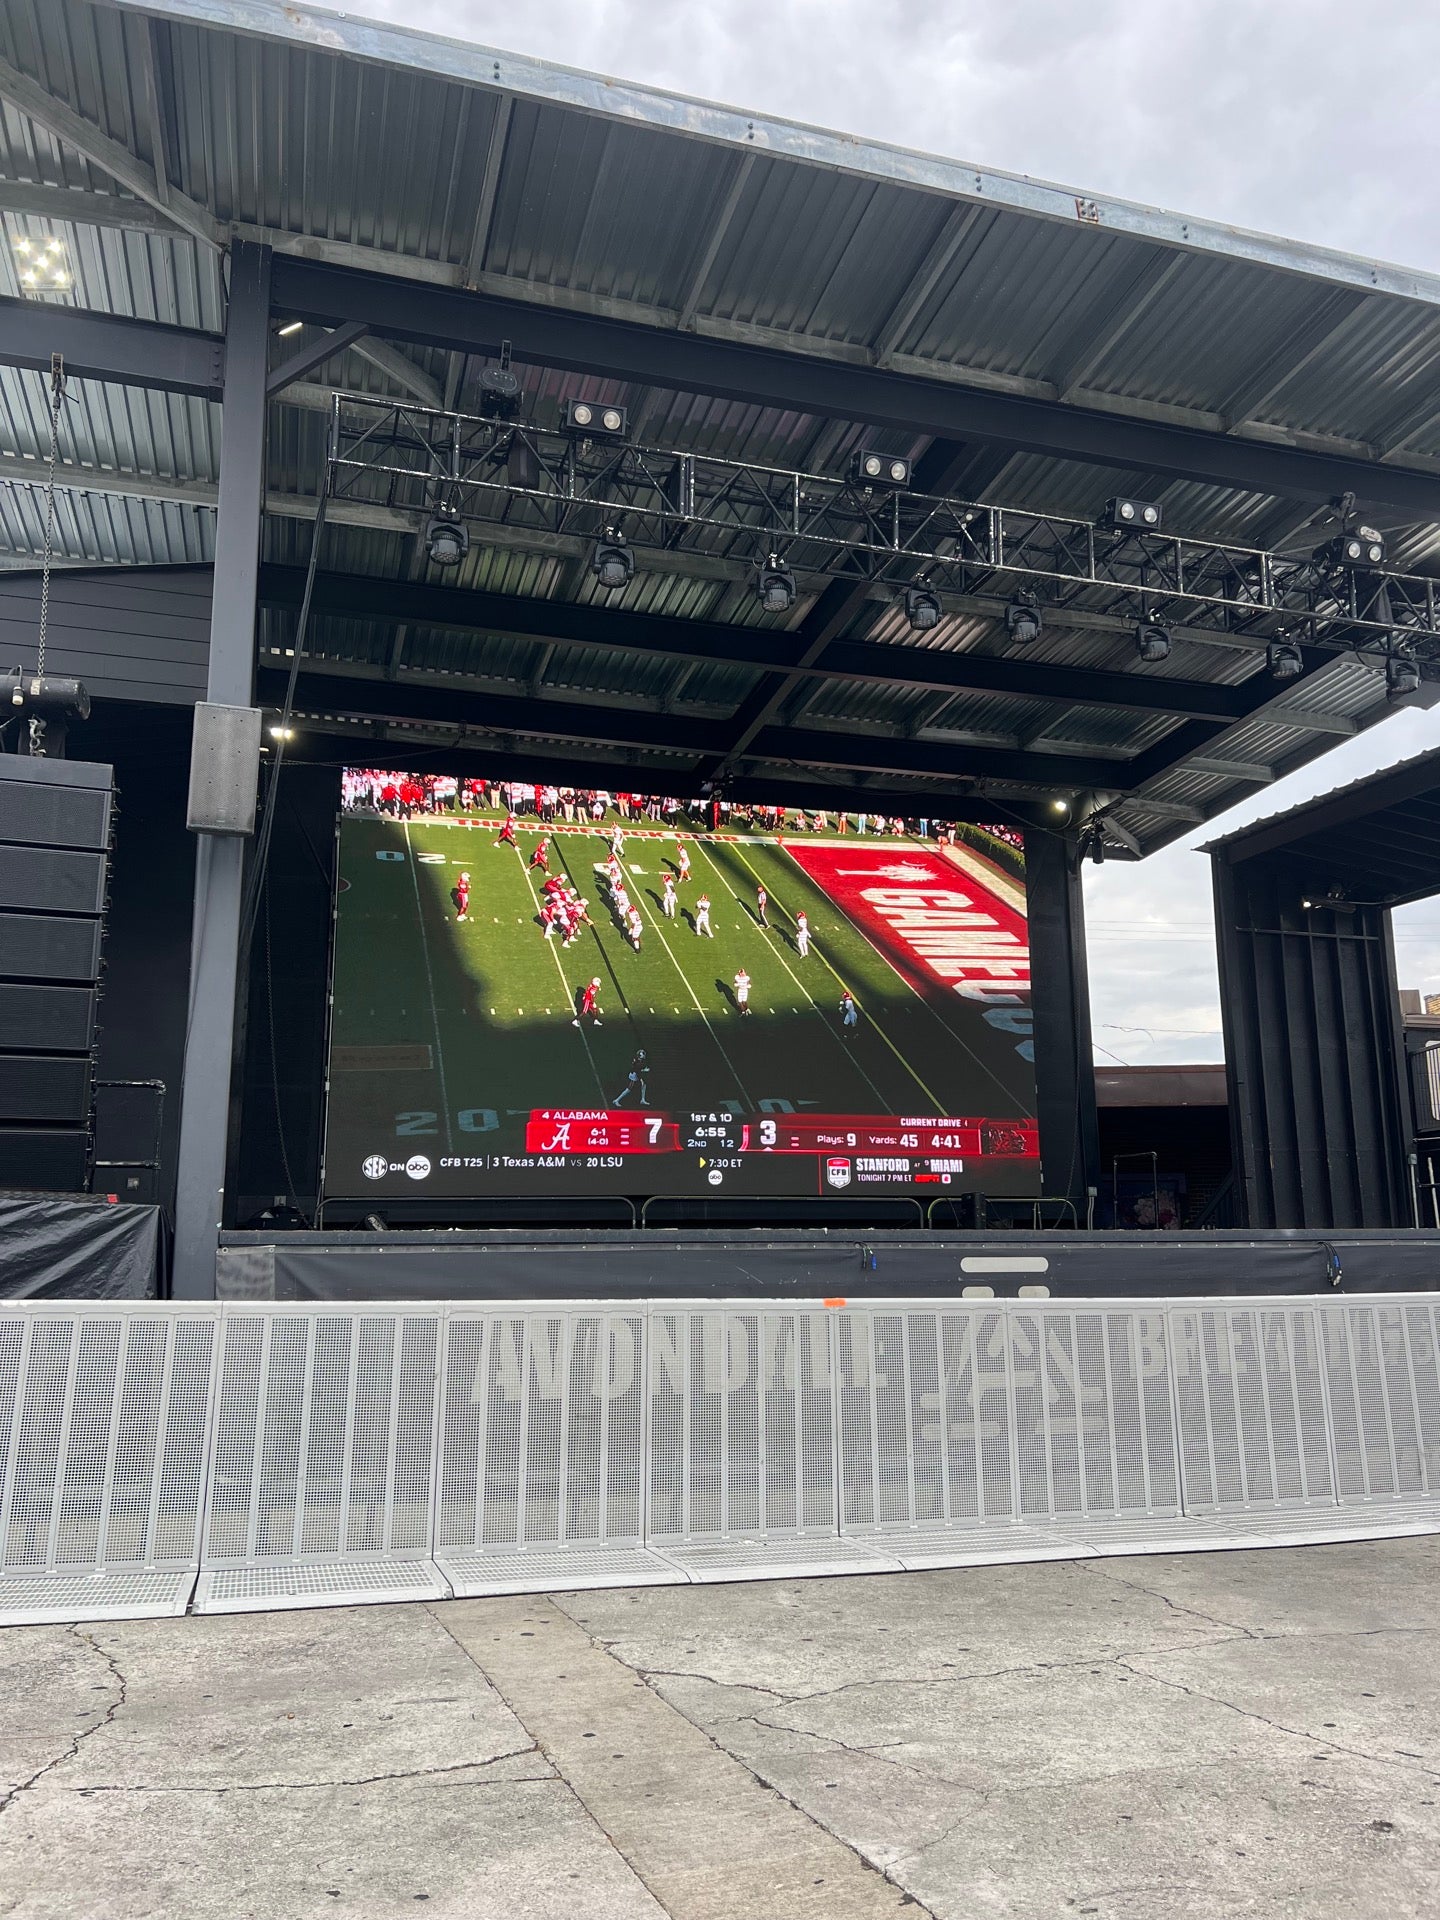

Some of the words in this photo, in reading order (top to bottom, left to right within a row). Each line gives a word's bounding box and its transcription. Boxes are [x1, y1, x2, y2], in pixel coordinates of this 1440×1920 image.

[542, 1111, 550, 1119] 4
[553, 1112, 609, 1121] ALABAMA
[708, 1113, 717, 1122] &
[719, 1113, 732, 1122] 10
[900, 1118, 936, 1127] CURRENT
[937, 1119, 961, 1128] DRIVE
[590, 1128, 606, 1136] 6-1
[644, 1118, 663, 1144] 7
[695, 1127, 726, 1137] 6:55
[759, 1120, 776, 1145] 3
[587, 1137, 609, 1146] (4-0)
[817, 1135, 844, 1144] Plays:
[846, 1133, 857, 1147] 9
[868, 1136, 898, 1145] Yards:
[899, 1134, 919, 1148] 45
[931, 1135, 962, 1149] 4:41
[440, 1158, 461, 1167] CFB
[463, 1158, 483, 1167] T25
[492, 1157, 500, 1167] 3
[502, 1157, 535, 1167] Texas
[537, 1157, 566, 1167] A&M
[570, 1159, 582, 1167] vs
[586, 1157, 598, 1167] 20
[600, 1157, 623, 1167] LSU
[708, 1158, 729, 1168] 7:30
[730, 1158, 743, 1168] ET
[856, 1158, 910, 1172] STANFORD
[930, 1159, 963, 1173] MIAMI
[389, 1163, 405, 1172] ON
[831, 1168, 847, 1176] CFB
[857, 1174, 886, 1182] TONIGHT
[887, 1174, 892, 1182] 7
[892, 1174, 903, 1182] PM
[904, 1174, 912, 1182] ET
